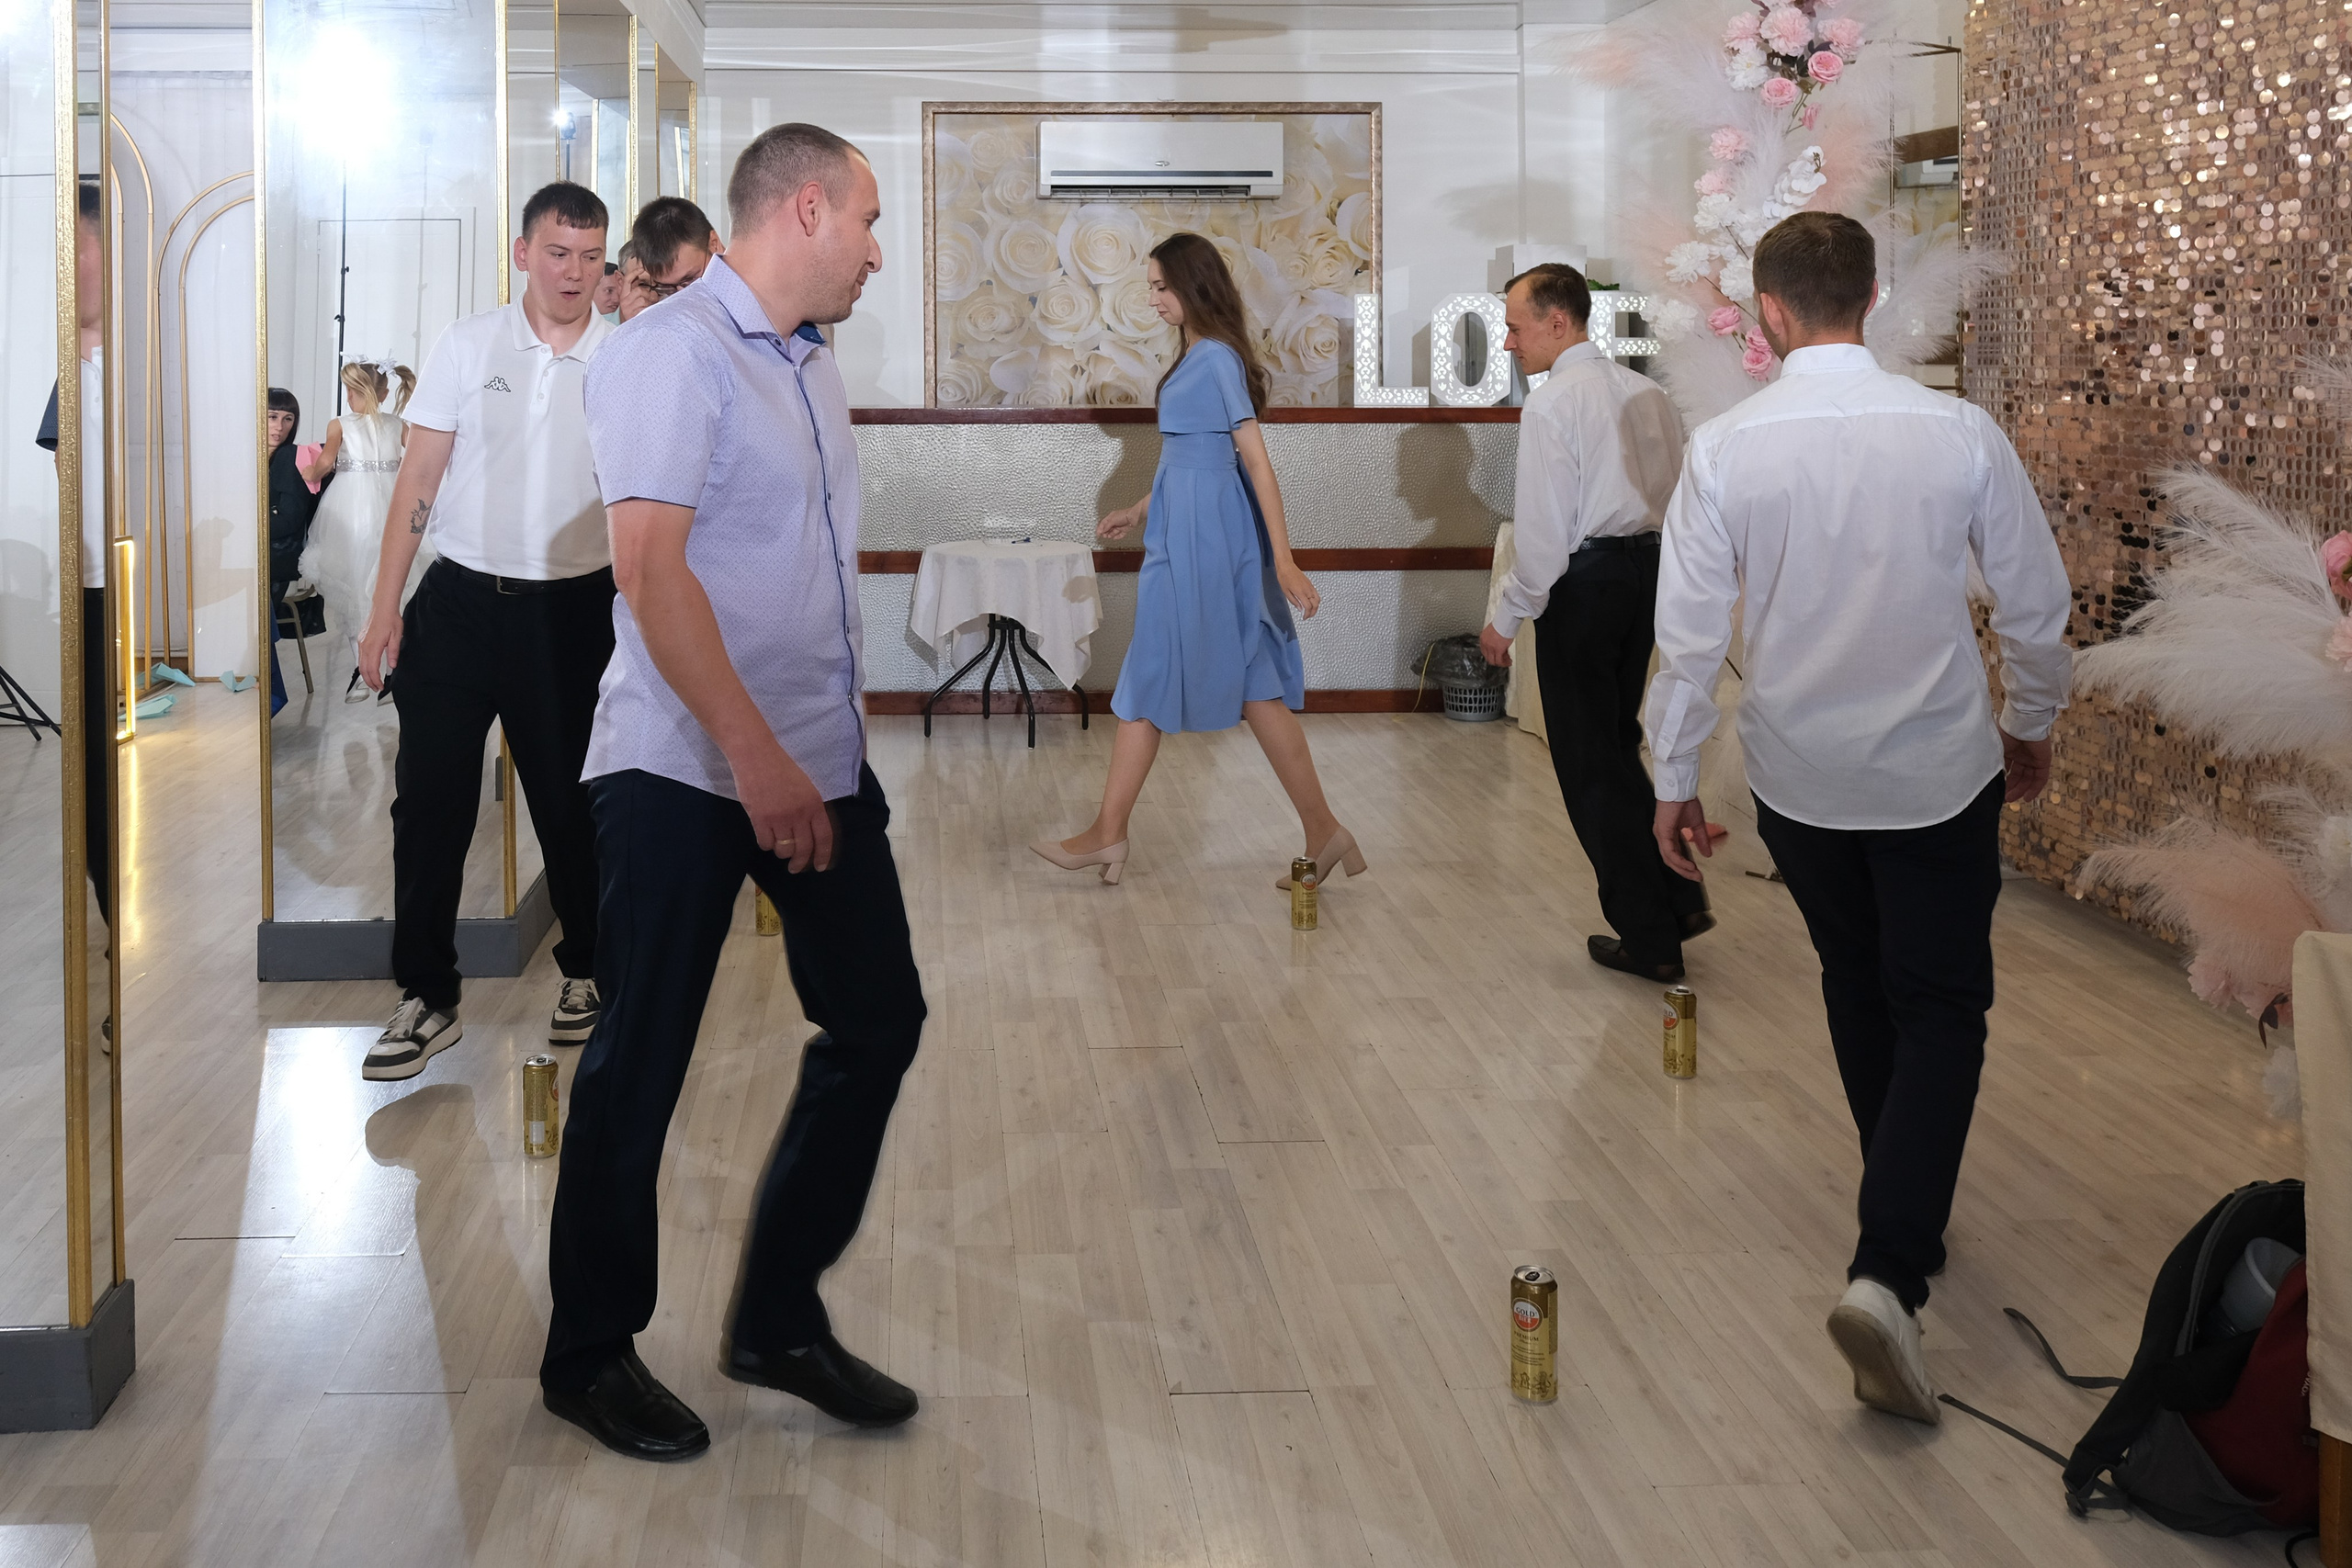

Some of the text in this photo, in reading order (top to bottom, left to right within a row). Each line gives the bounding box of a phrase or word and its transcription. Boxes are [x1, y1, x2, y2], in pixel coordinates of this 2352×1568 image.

[1354, 291, 1661, 407] LOE
[1516, 1307, 1535, 1317] GOLD
[1514, 1330, 1539, 1341] PREMIUM
